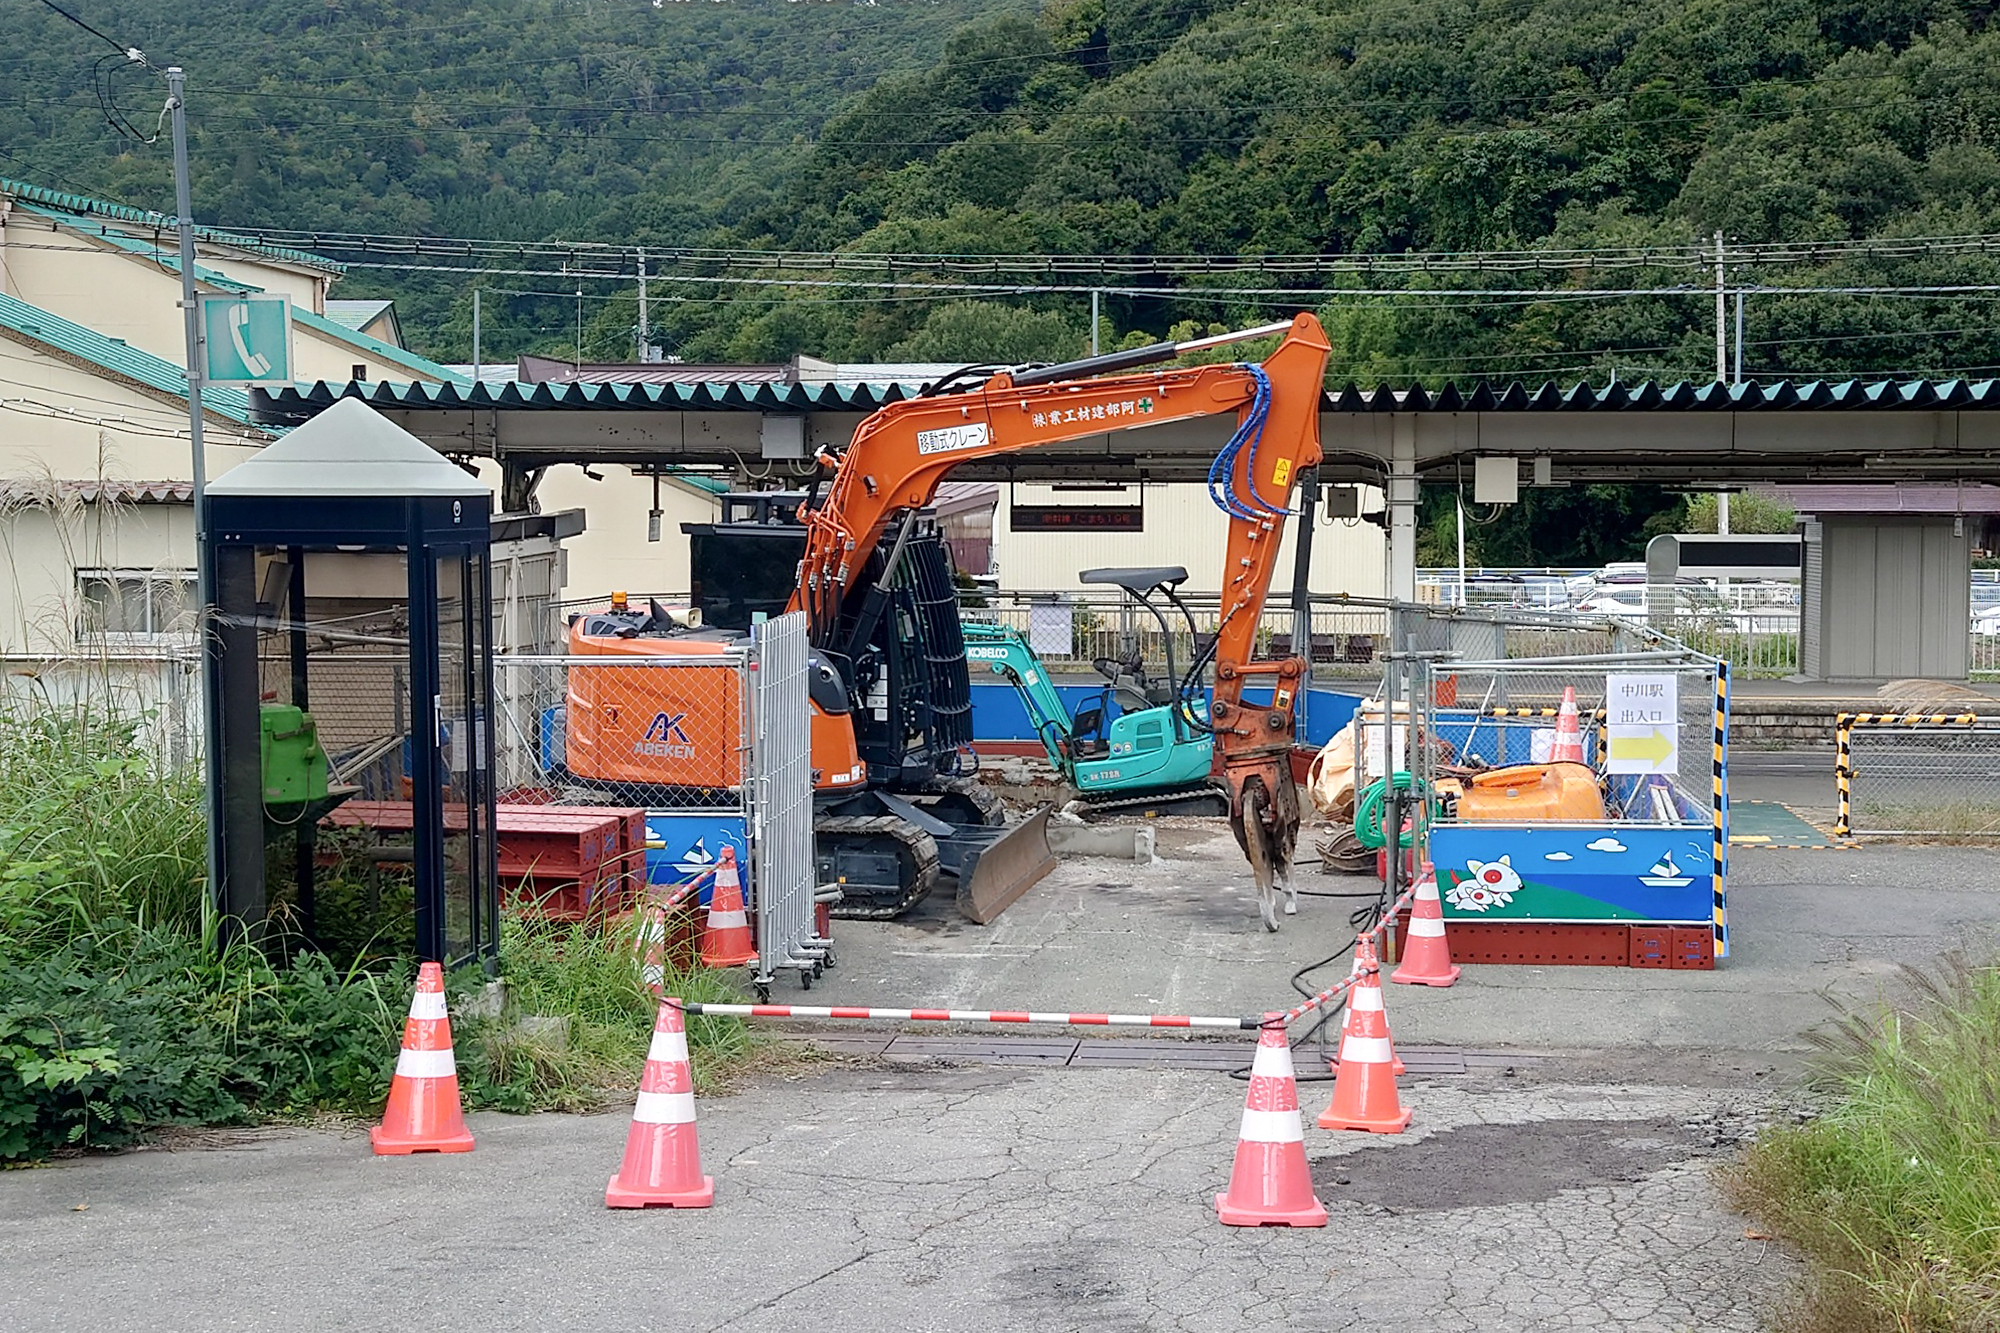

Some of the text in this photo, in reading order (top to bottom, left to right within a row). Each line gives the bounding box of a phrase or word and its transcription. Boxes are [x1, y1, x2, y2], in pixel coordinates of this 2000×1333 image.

[919, 426, 987, 453] 移動式クレーン
[967, 647, 1009, 659] KOBELCO
[1621, 683, 1664, 697] 中川駅
[1621, 709, 1662, 723] 出入口
[634, 741, 695, 758] ABEKEN
